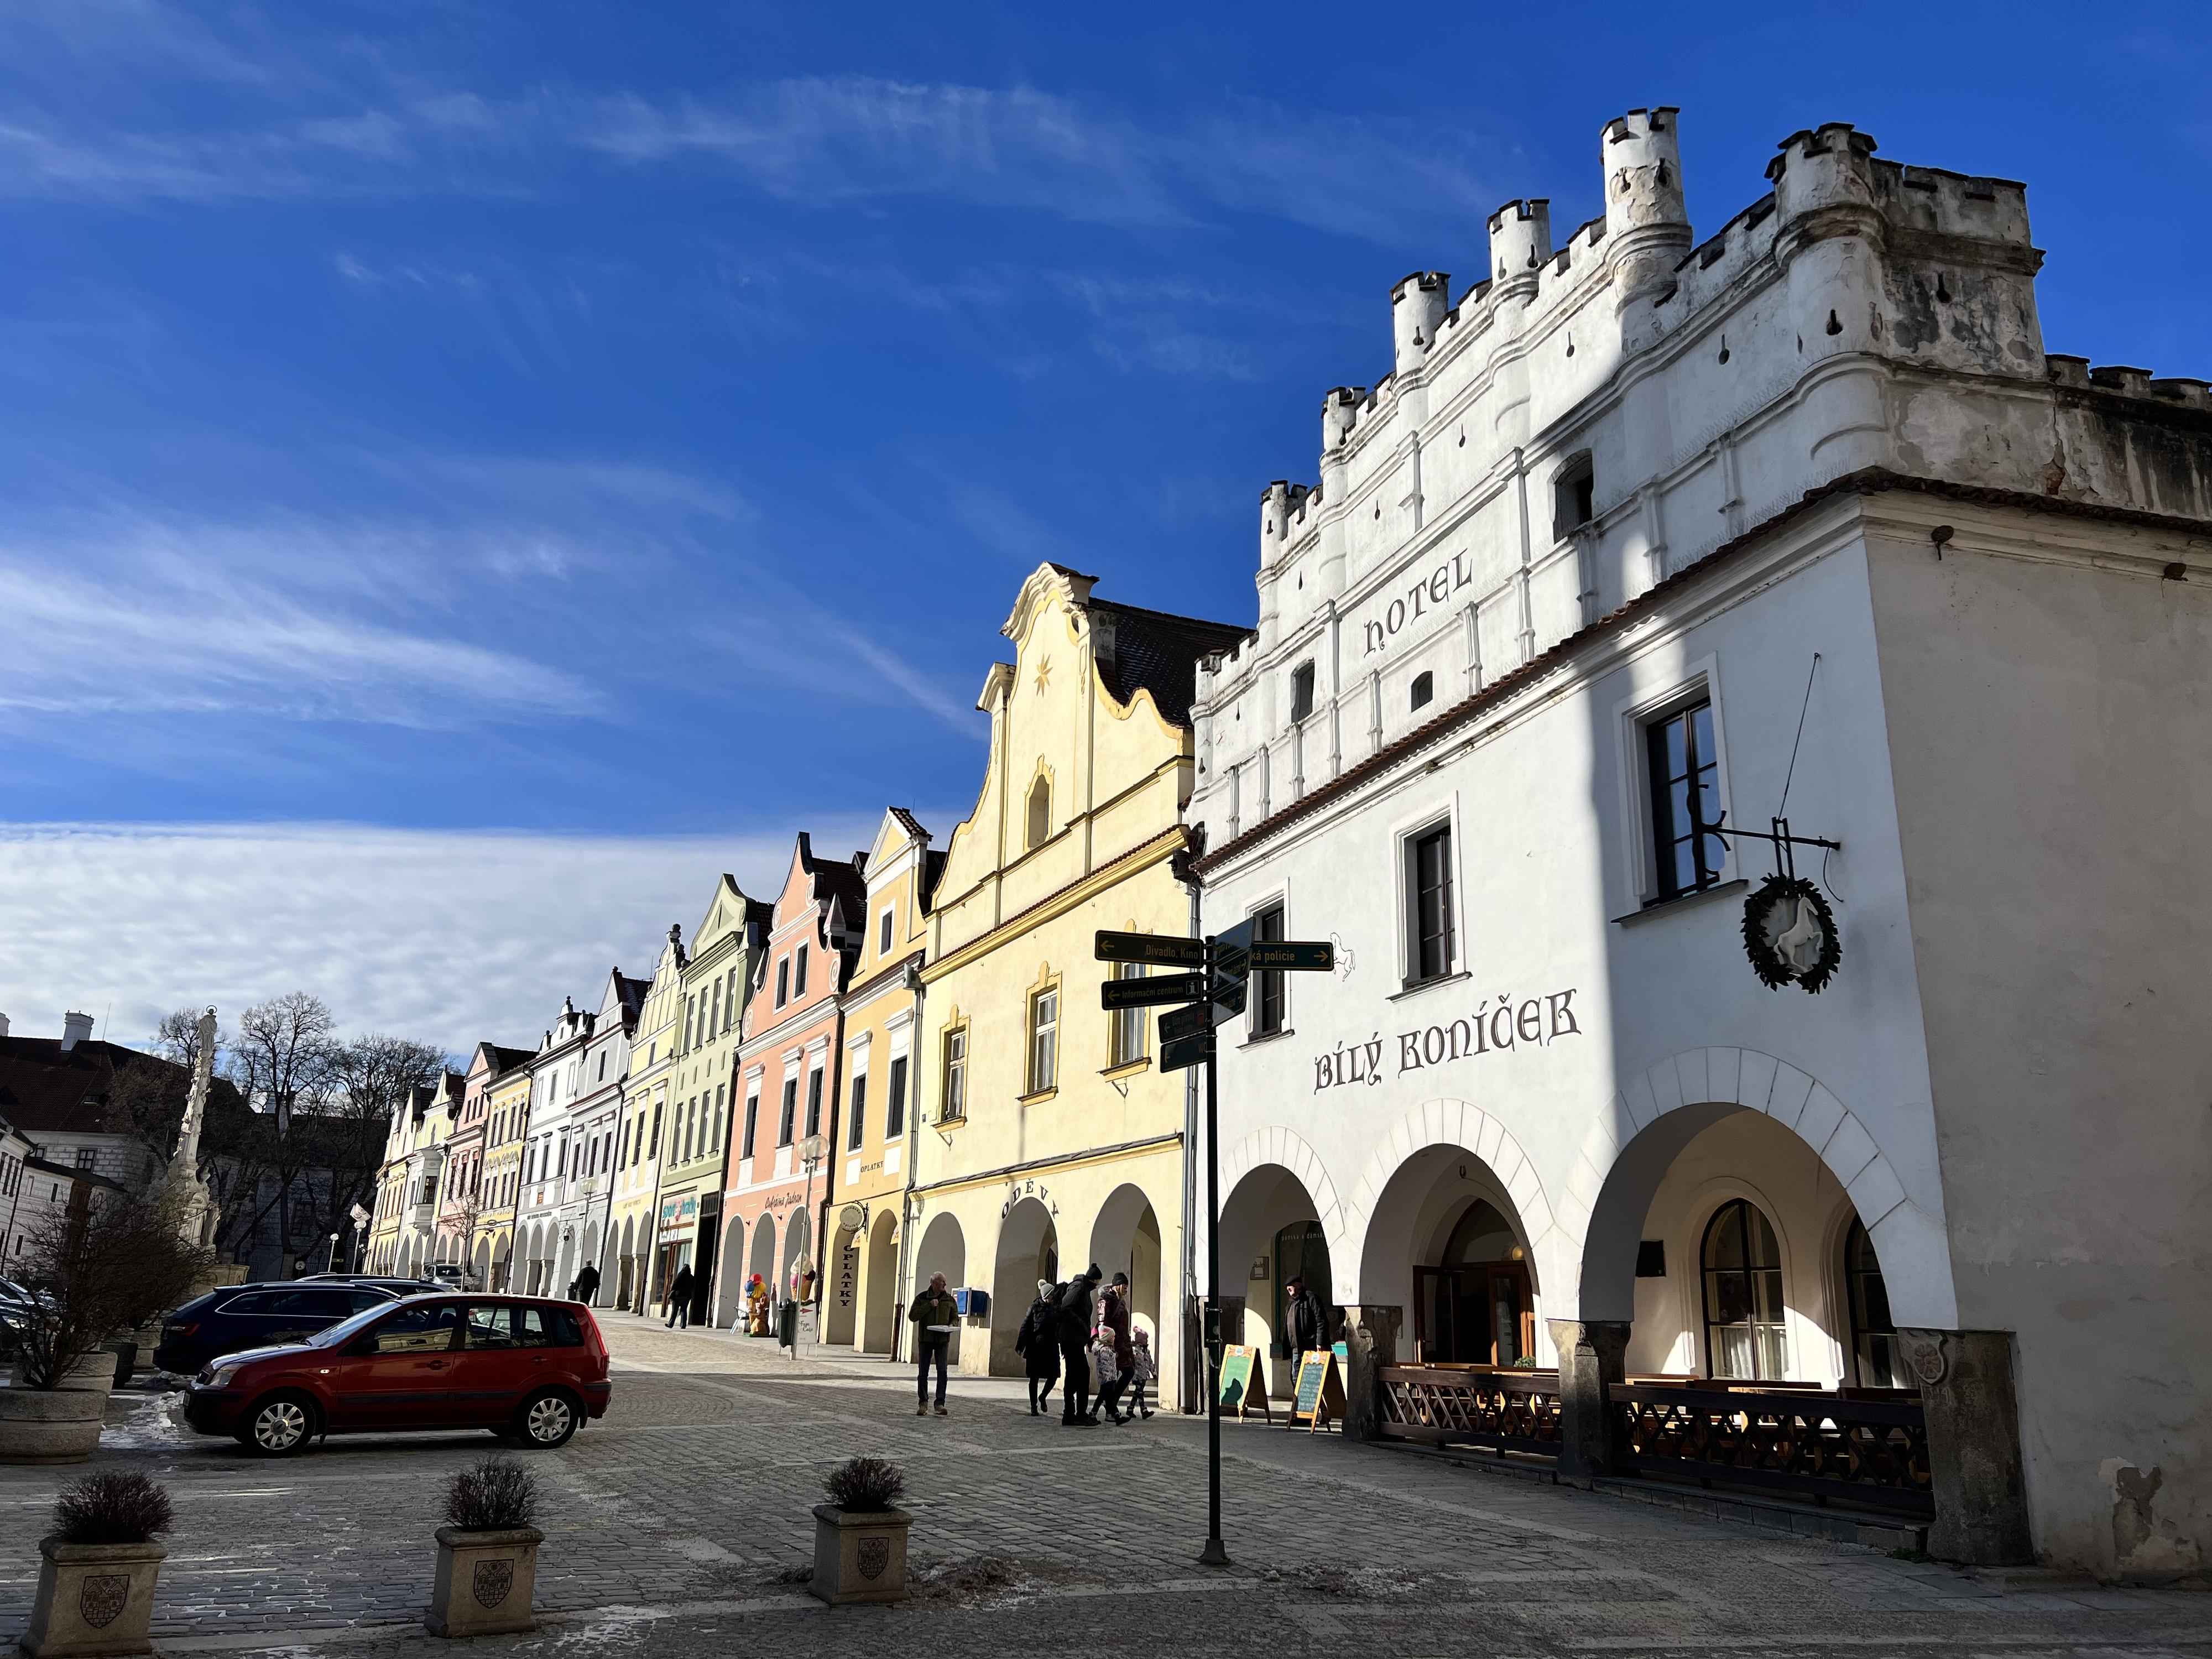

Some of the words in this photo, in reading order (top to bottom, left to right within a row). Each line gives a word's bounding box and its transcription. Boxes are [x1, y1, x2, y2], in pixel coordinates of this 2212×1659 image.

[1364, 547, 1473, 658] HOTEL
[1146, 944, 1178, 958] Divadlo,
[1180, 948, 1198, 959] Kino
[1265, 950, 1295, 963] policie
[1122, 988, 1155, 999] Informační
[1157, 986, 1183, 995] centrum
[1314, 1031, 1383, 1095] BÍLÝ
[1397, 988, 1582, 1079] KONÍČEK
[860, 1160, 884, 1173] OPLATKY
[1001, 1177, 1060, 1219] ODĚVY
[839, 1245, 855, 1306] OPLATKY
